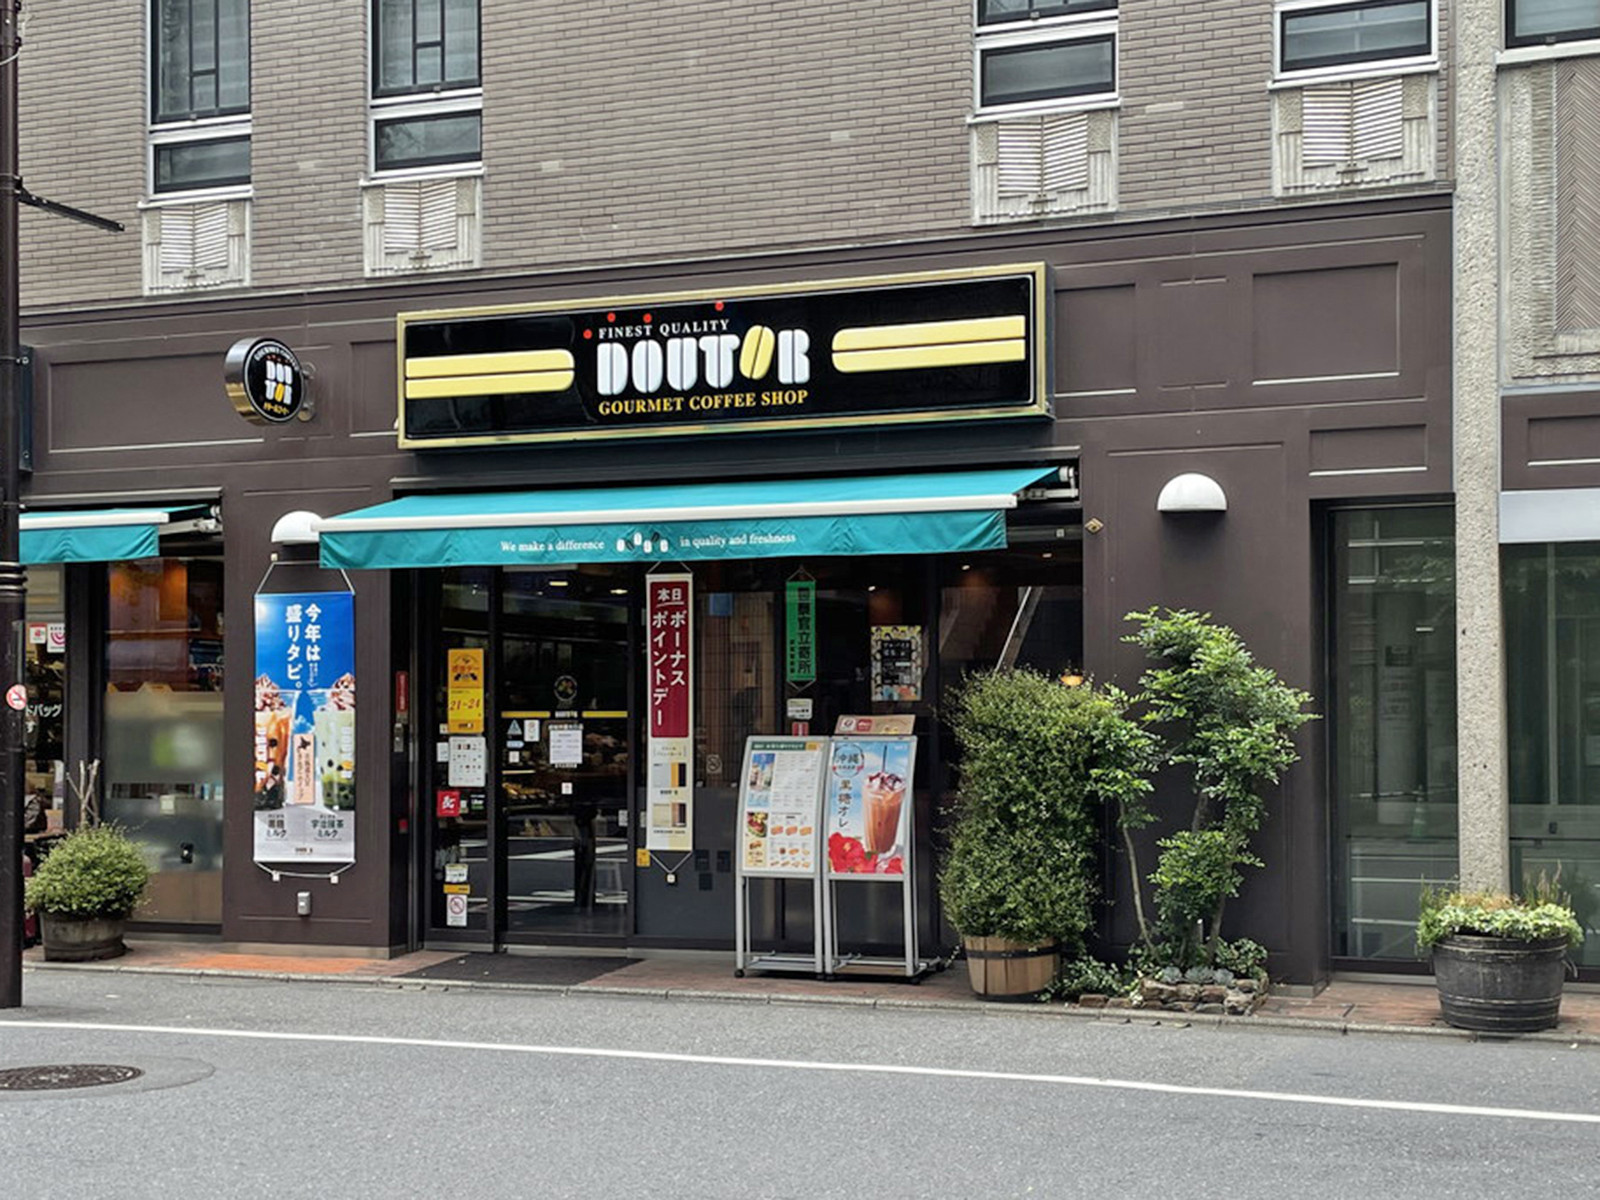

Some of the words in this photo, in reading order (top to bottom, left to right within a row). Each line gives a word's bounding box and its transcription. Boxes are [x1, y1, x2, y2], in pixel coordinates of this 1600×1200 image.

[599, 325, 653, 339] FINEST
[659, 319, 730, 337] QUALITY
[597, 325, 810, 396] DOUTOR
[599, 397, 684, 415] GOURMET
[689, 392, 757, 411] COFFEE
[761, 389, 809, 407] SHOP
[500, 540, 513, 551] We
[517, 540, 545, 551] make
[555, 539, 605, 550] difference
[680, 536, 691, 547] in
[692, 535, 727, 549] quality
[729, 534, 747, 545] and
[749, 532, 797, 544] freshness
[657, 588, 682, 602] 本日
[305, 603, 322, 662] 今年は
[670, 610, 687, 686] ボーナス
[652, 611, 669, 726] ポイントデー
